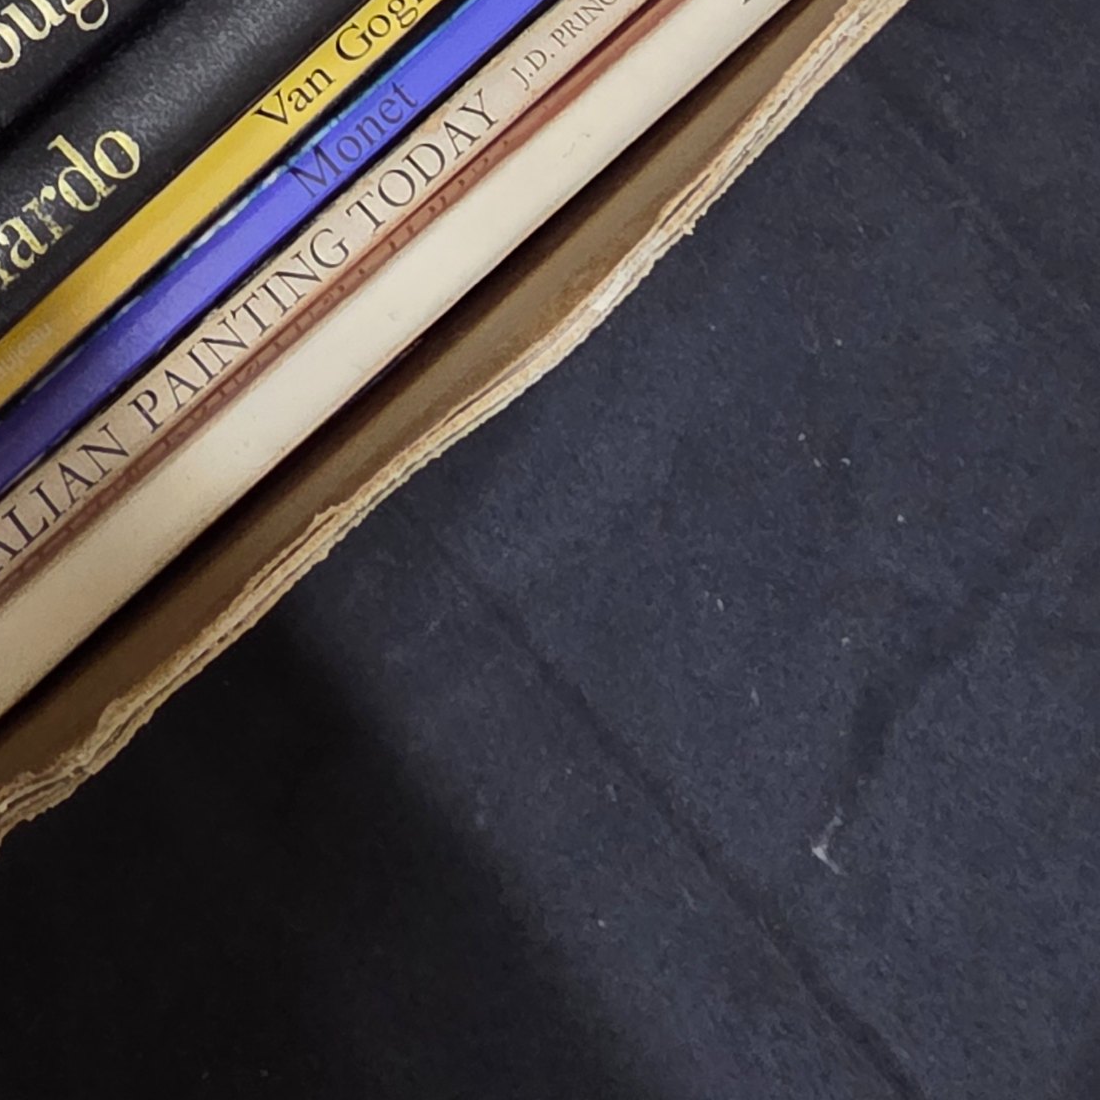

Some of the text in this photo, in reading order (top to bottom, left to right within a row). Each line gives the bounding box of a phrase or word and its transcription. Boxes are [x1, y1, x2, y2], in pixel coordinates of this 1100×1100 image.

[253, 64, 337, 130] Van
[287, 80, 419, 200] Monet
[128, 227, 350, 434] PAINTING
[345, 88, 499, 235] TODAY
